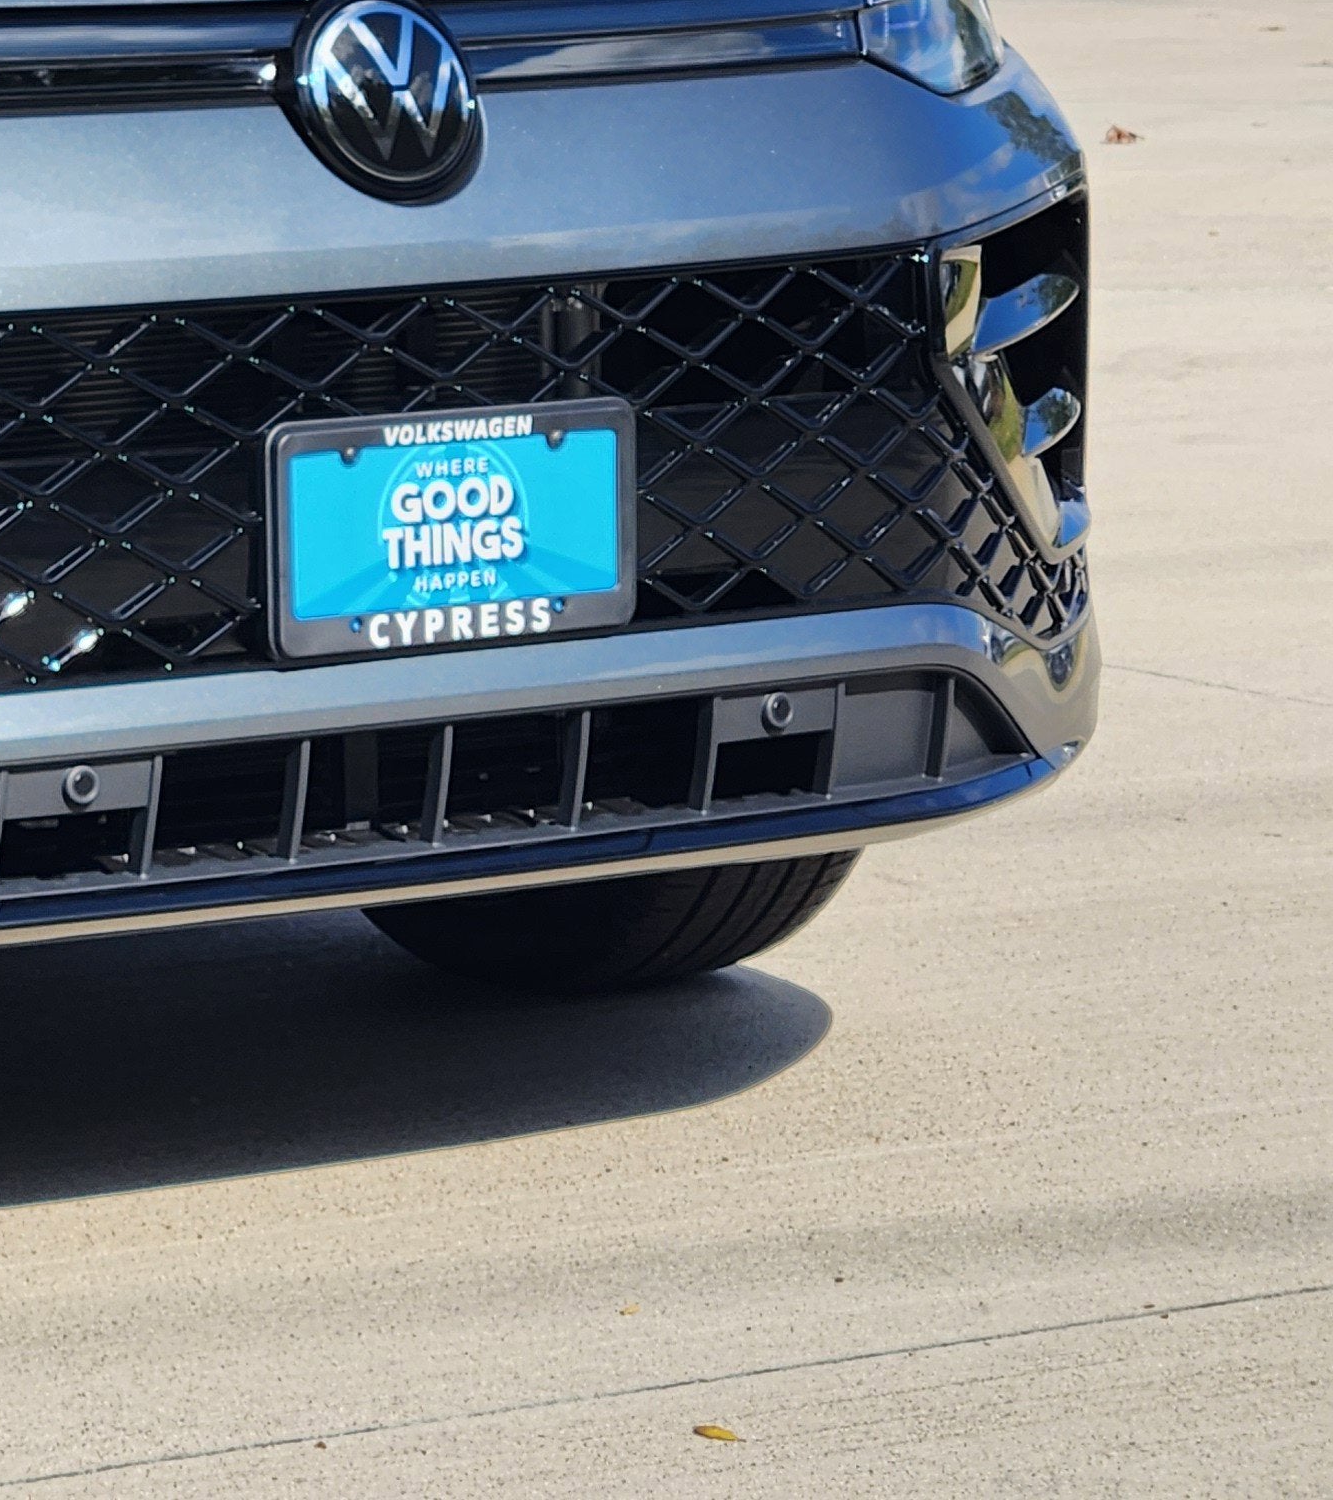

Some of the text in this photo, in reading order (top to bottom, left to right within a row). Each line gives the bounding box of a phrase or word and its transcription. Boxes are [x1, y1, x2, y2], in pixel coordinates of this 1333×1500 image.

[384, 414, 533, 447] VOLKSWAGEN
[415, 457, 490, 478] WHERE
[391, 475, 514, 524] GOOD
[382, 516, 526, 569] THINGS
[415, 570, 497, 592] HAPPEN
[369, 597, 552, 649] CYPRESS
